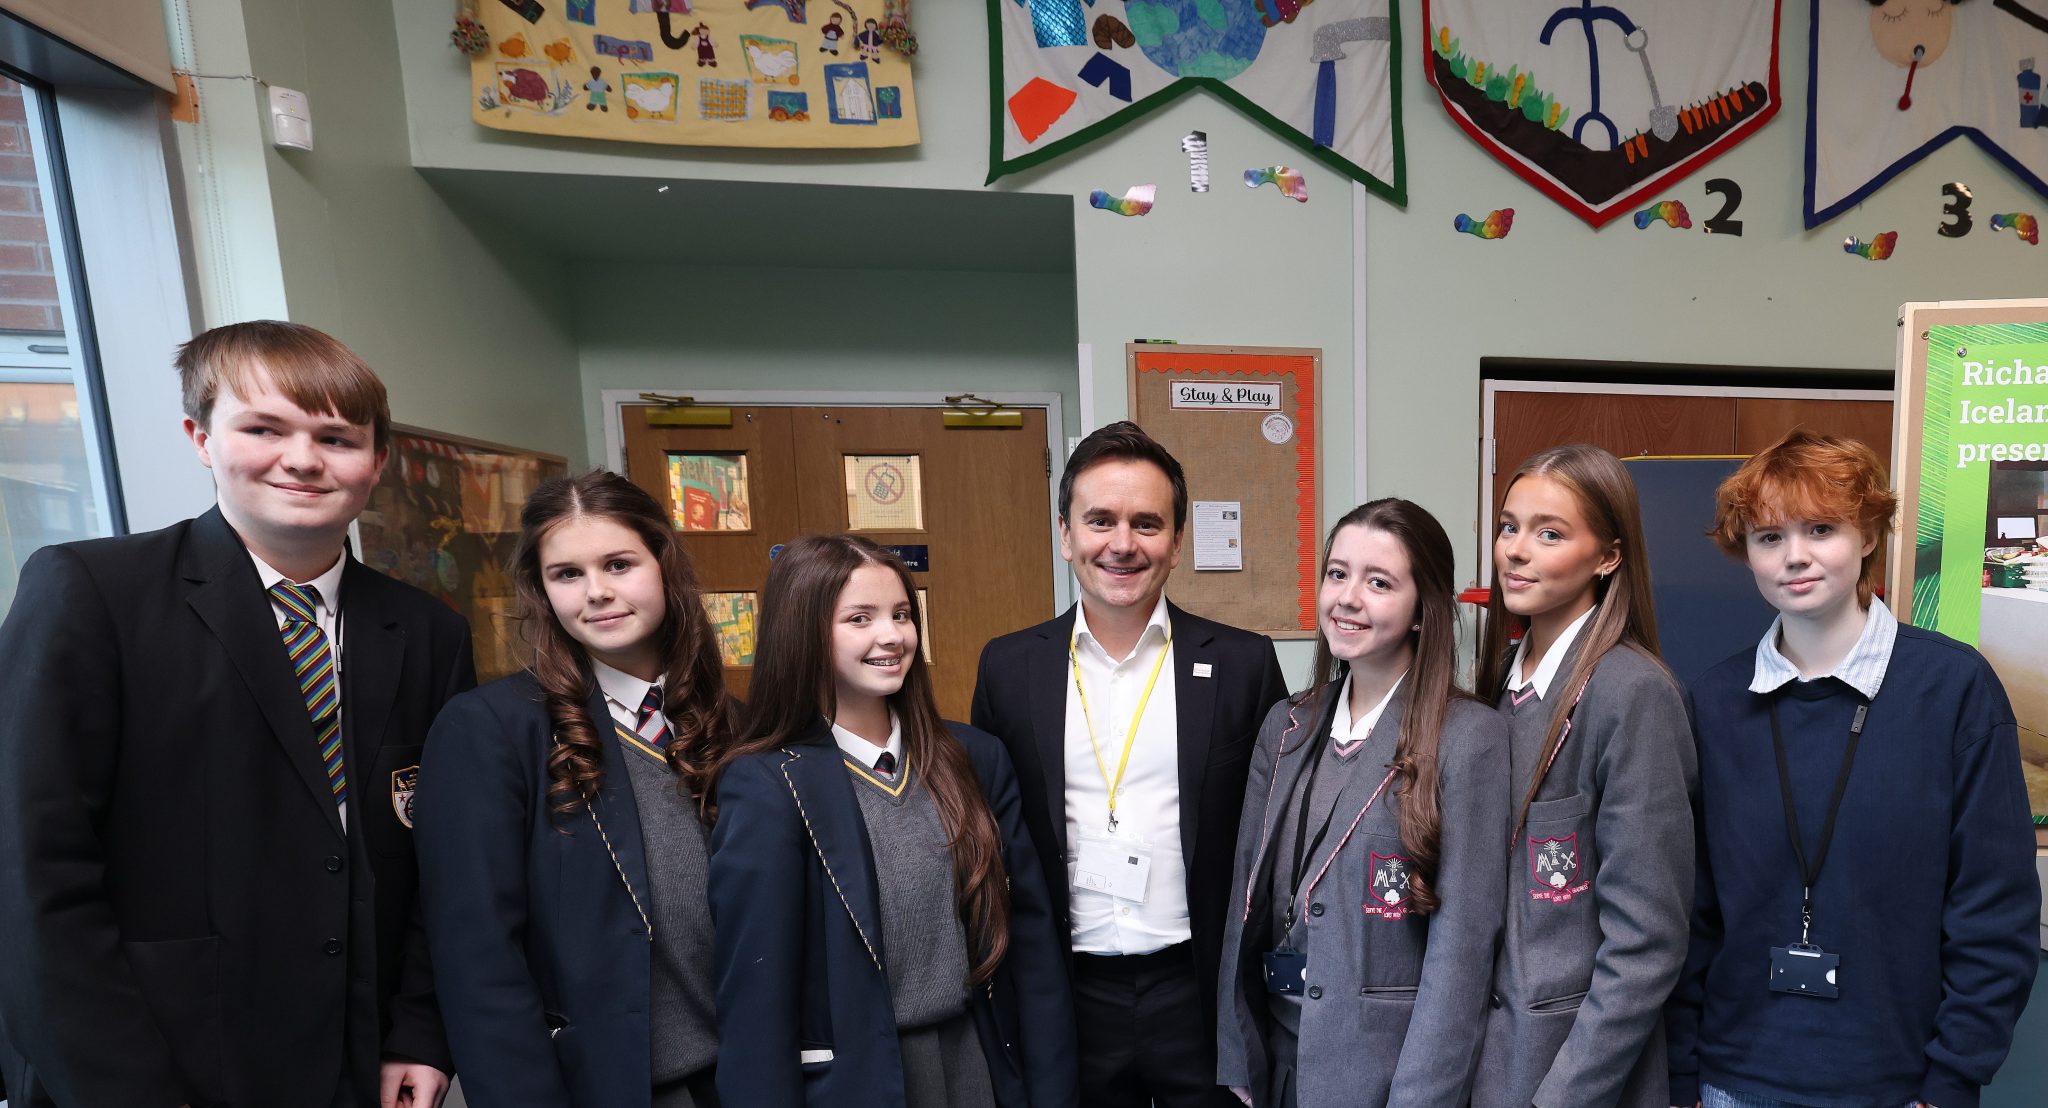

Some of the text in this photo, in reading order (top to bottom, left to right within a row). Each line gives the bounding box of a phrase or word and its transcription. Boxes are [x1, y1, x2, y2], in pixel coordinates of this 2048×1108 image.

[1182, 130, 1209, 192] 1
[1704, 178, 1742, 236] 2
[1938, 182, 1973, 238] 3
[1962, 359, 2048, 386] Richa
[1180, 386, 1274, 406] Stay & Play
[1957, 443, 2048, 468] prese
